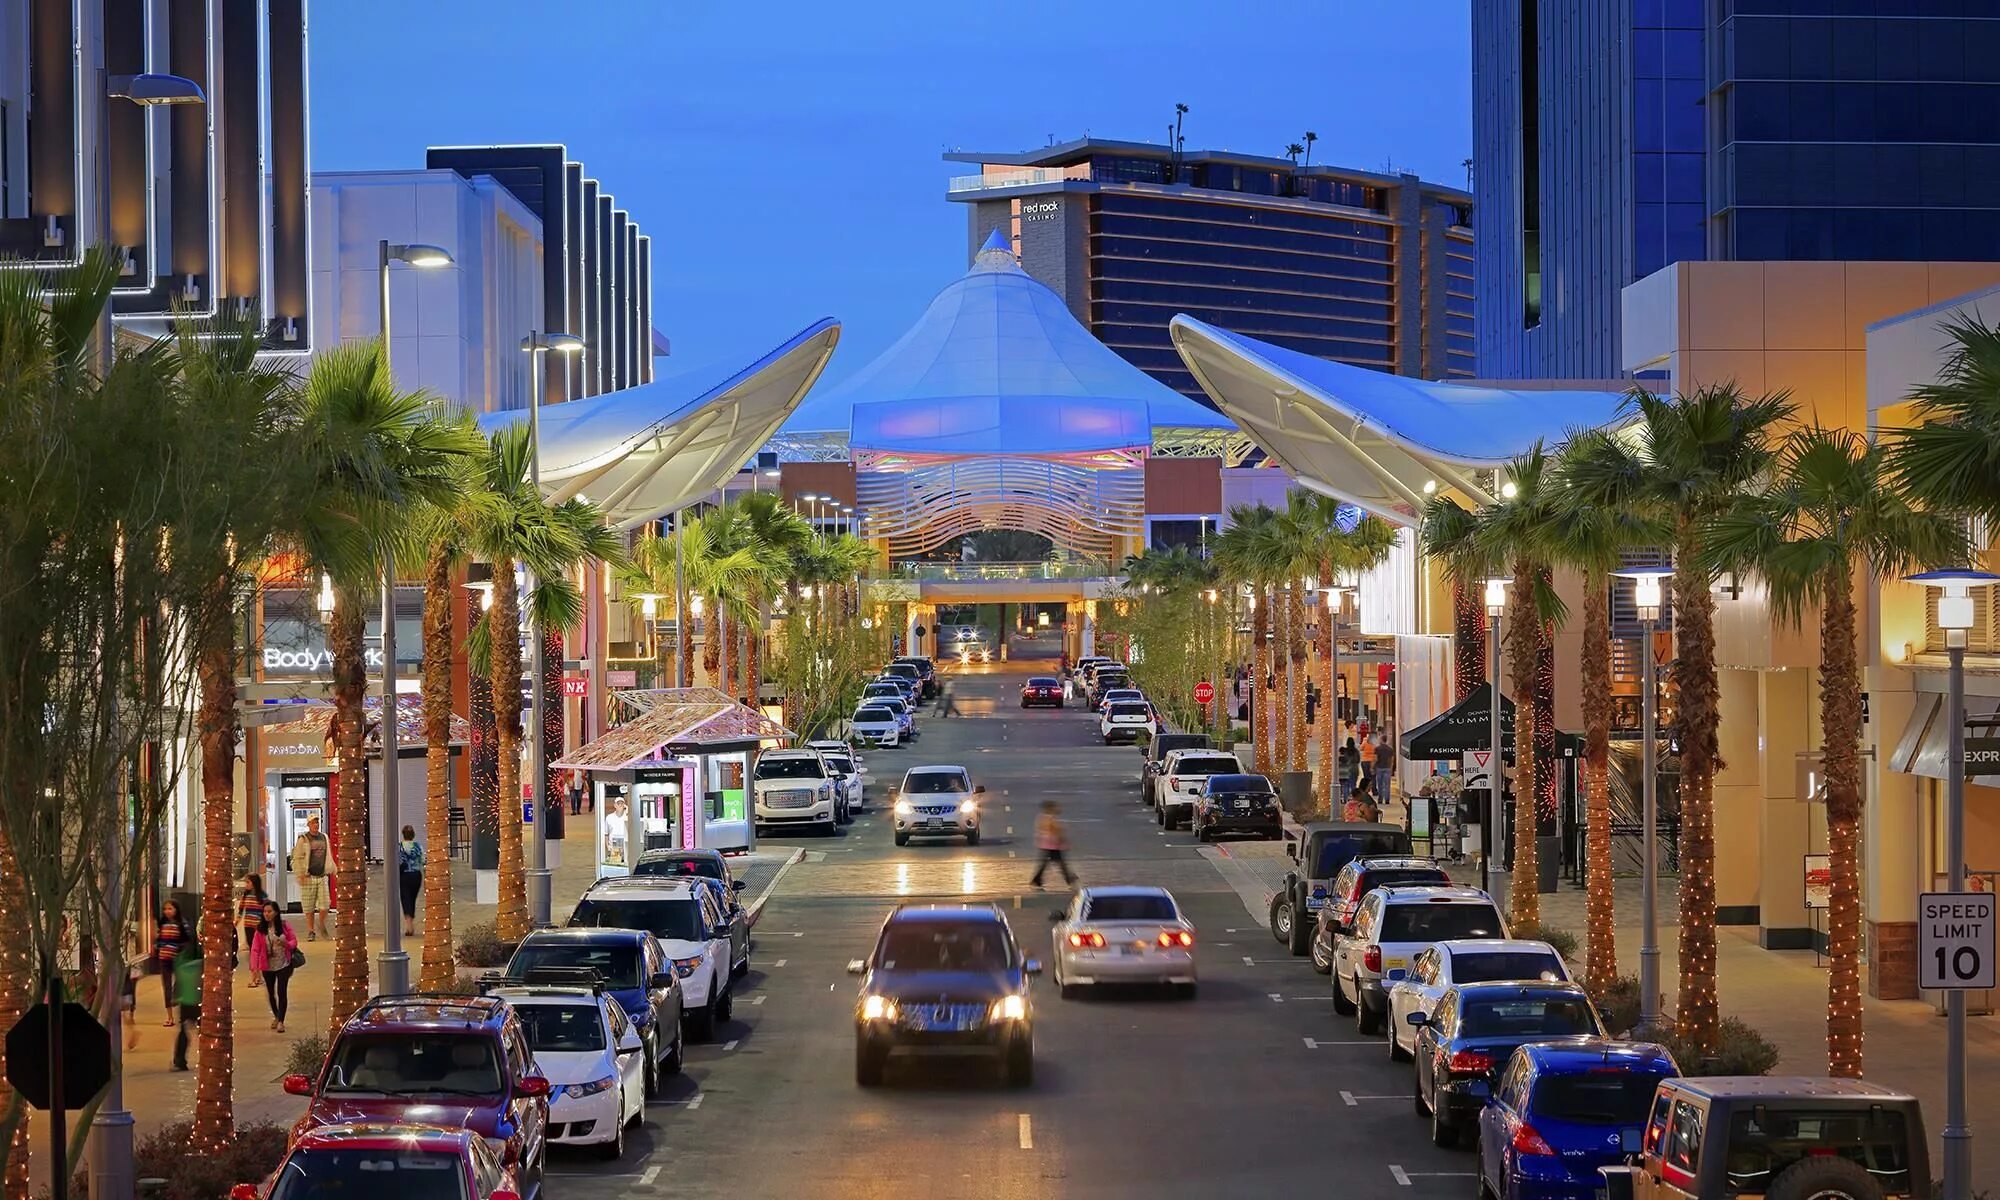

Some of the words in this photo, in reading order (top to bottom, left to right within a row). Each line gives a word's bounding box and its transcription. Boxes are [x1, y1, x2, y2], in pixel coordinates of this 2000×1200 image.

[1023, 202, 1038, 213] red
[1039, 200, 1059, 212] rock
[1028, 213, 1055, 222] CASINO
[263, 648, 322, 671] Body
[564, 682, 585, 693] NK
[1195, 688, 1213, 698] STOP
[268, 744, 321, 756] PANDORA
[1478, 780, 1487, 788] TO
[685, 783, 693, 846] SUMMERLIN
[1926, 904, 1989, 919] SPEED
[1933, 924, 1982, 938] LIMIT
[1935, 946, 1980, 980] 10
